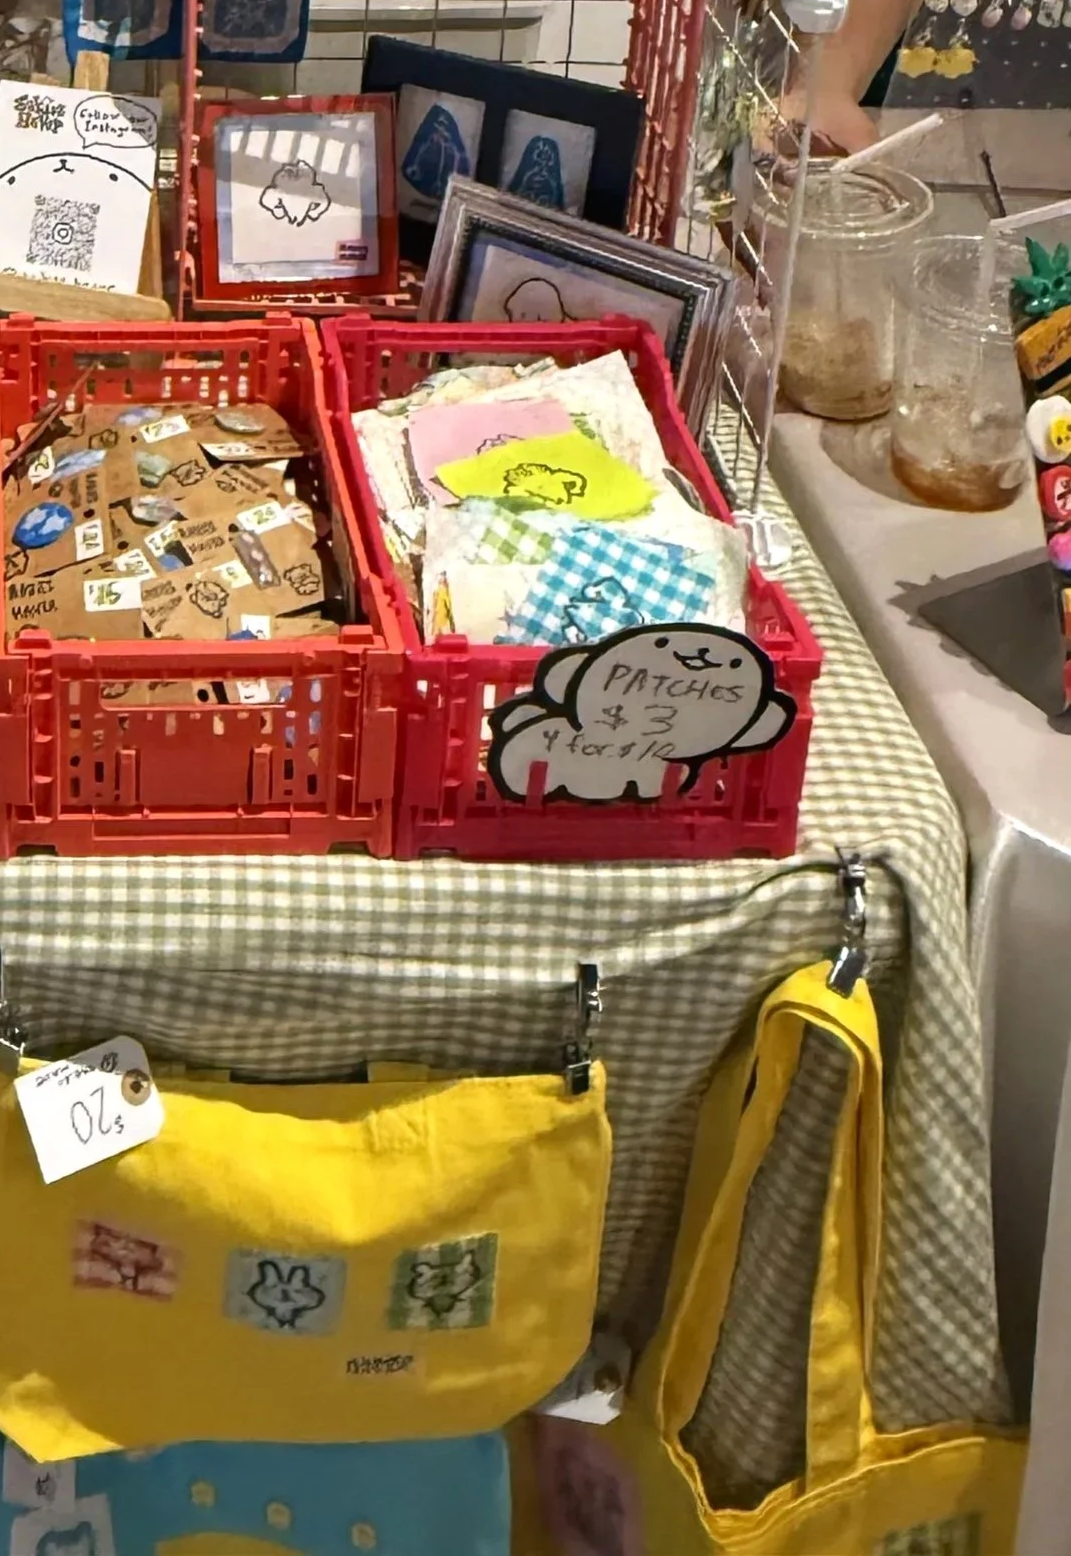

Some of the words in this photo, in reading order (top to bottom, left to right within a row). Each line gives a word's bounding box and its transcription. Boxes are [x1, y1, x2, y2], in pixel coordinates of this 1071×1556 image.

[80, 108, 120, 121] Follow
[604, 661, 744, 703] PATCHES
[543, 729, 560, 750] 4
